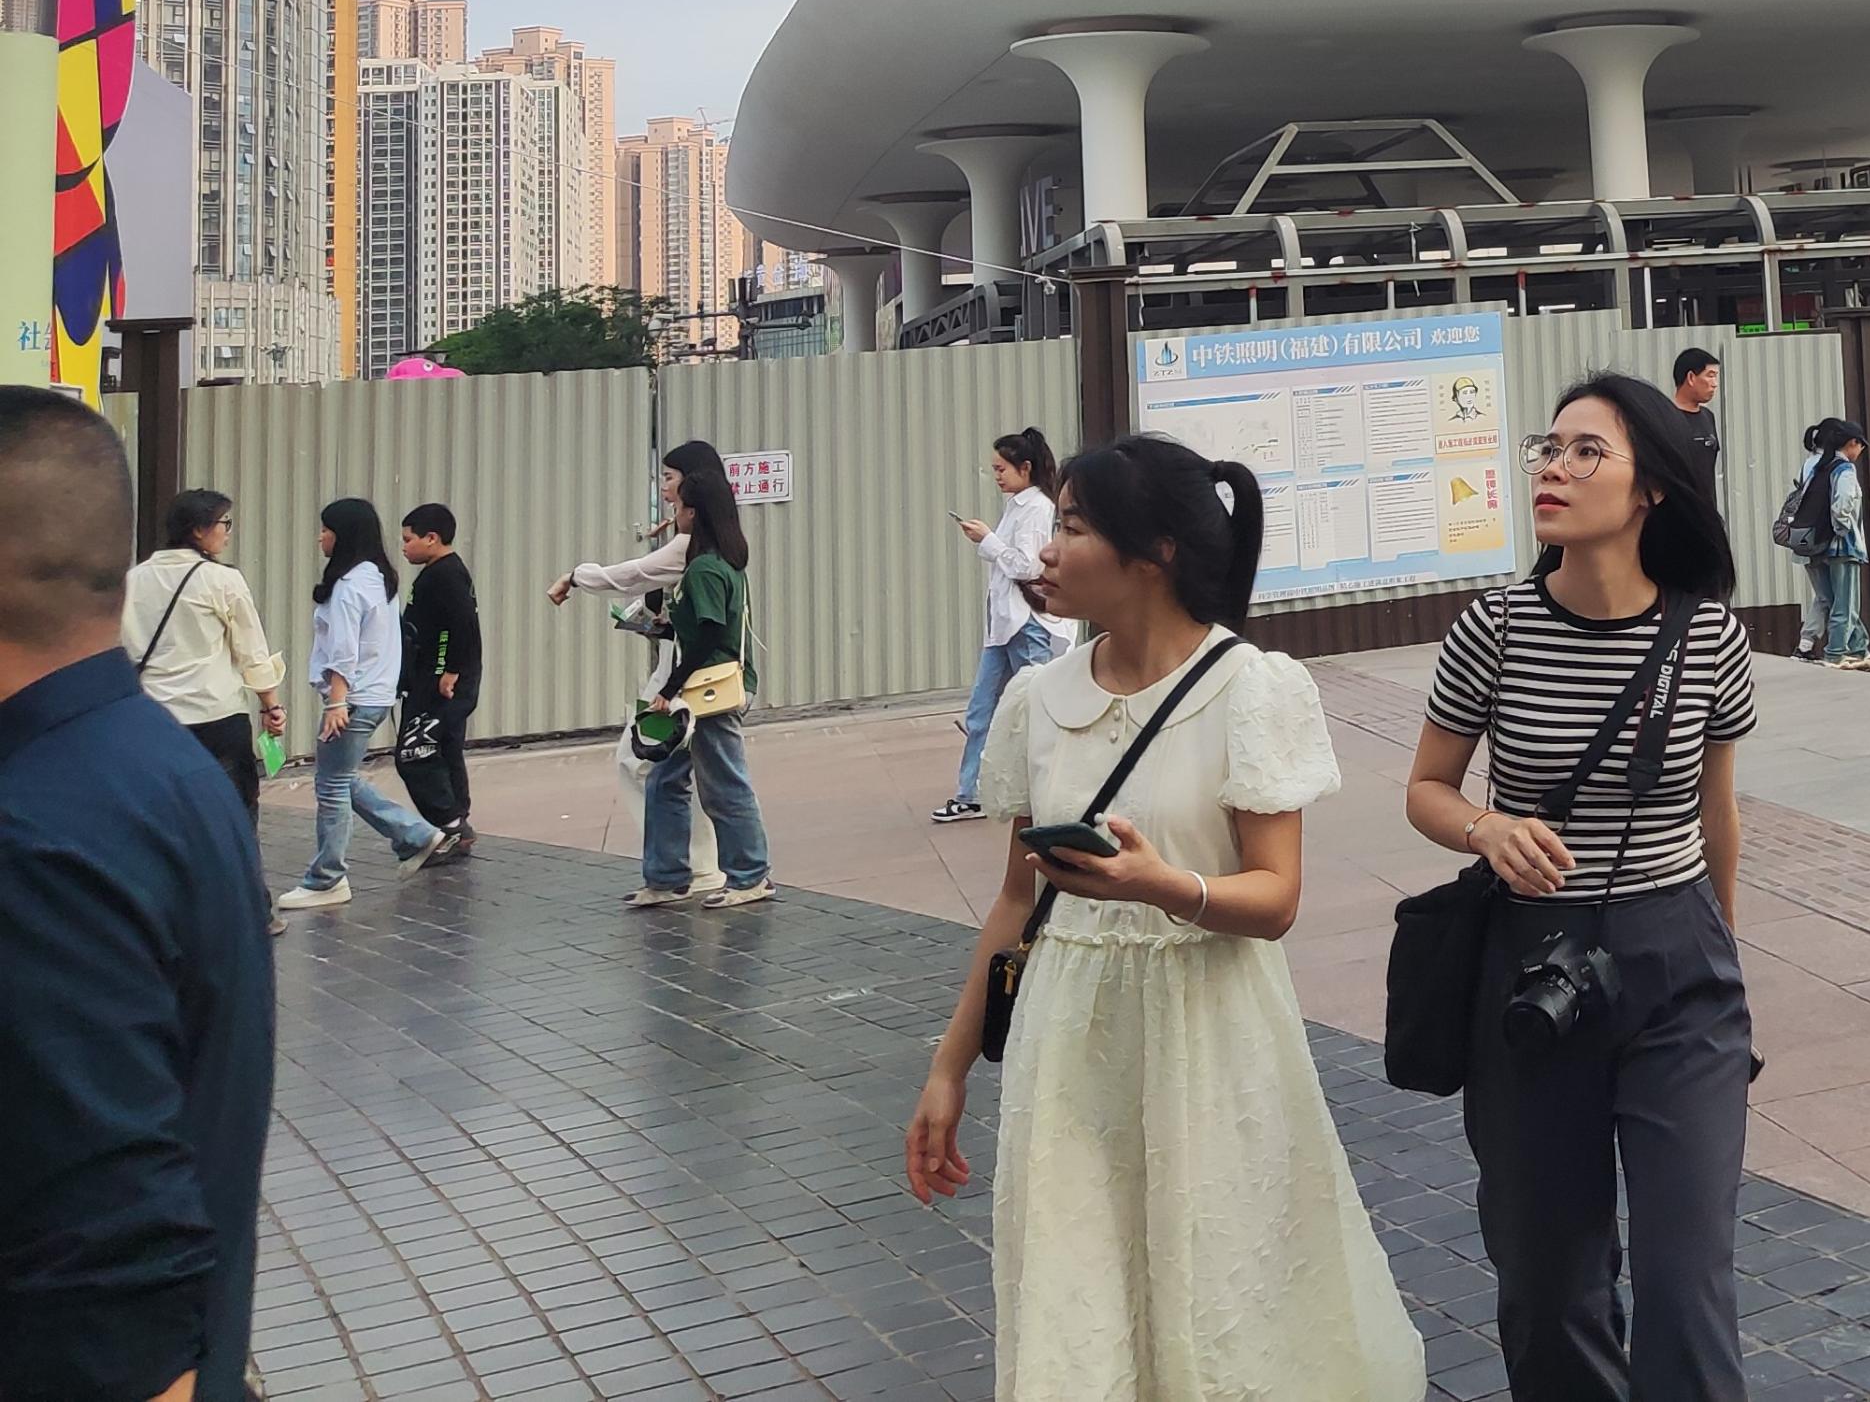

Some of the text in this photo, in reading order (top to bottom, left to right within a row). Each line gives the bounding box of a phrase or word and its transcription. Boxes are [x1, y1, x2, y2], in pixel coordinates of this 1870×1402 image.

[1192, 325, 1481, 369] 中铁照明(福建)有限公司 欢迎您
[728, 460, 785, 478] 前方施工
[1649, 664, 1674, 719] DIGITAL
